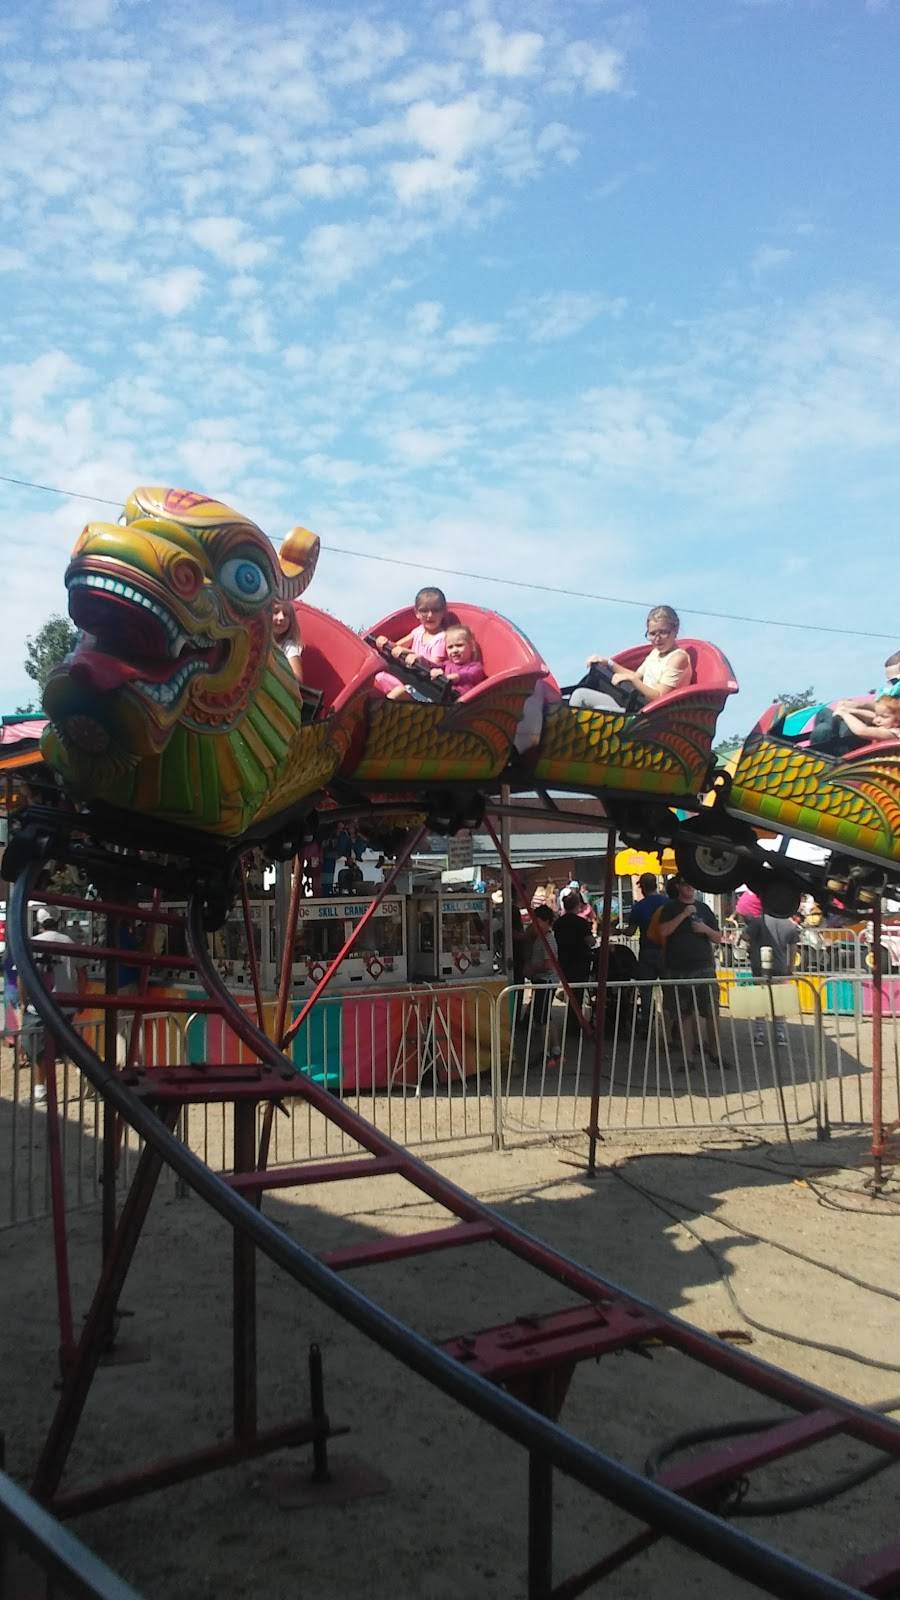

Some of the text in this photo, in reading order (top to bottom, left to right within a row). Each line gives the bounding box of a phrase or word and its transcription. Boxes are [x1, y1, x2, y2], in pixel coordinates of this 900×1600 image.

[299, 908, 309, 918] 0¢
[318, 907, 338, 918] SKILL
[382, 904, 397, 914] 50¢
